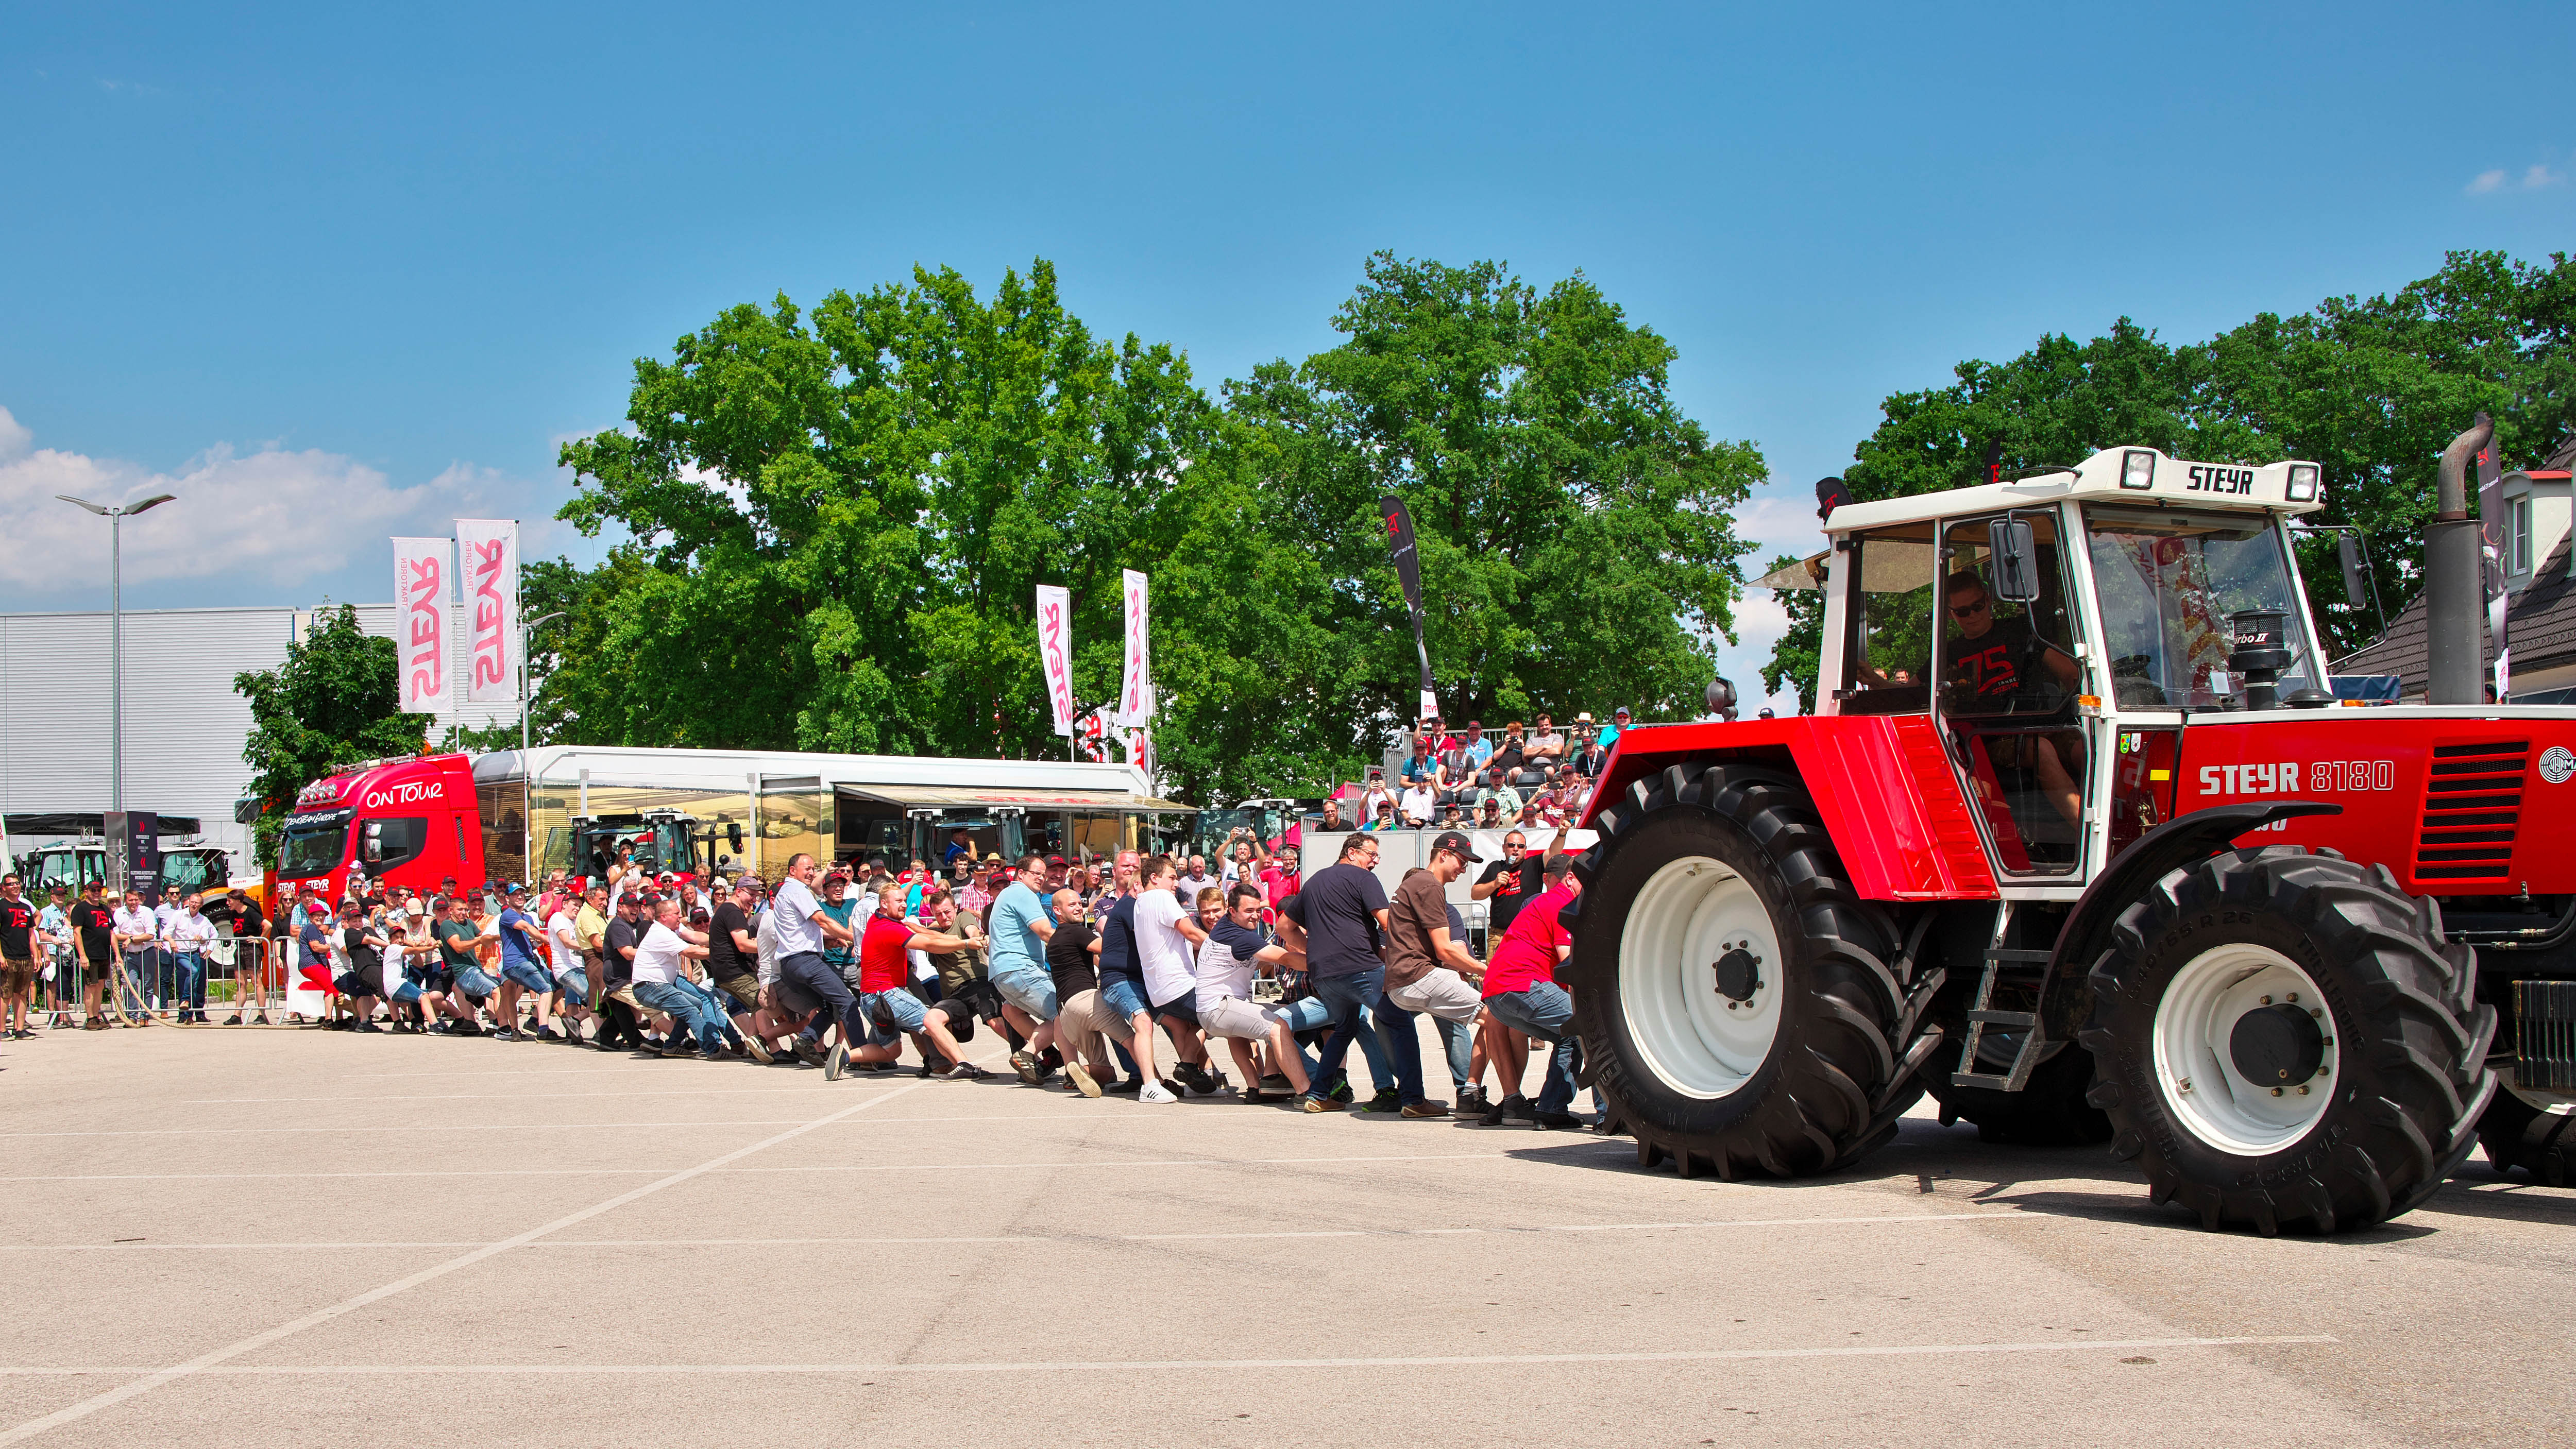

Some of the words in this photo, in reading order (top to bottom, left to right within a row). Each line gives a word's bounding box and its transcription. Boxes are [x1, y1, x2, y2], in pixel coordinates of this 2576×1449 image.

[2187, 465, 2253, 495] STEYR
[1958, 644, 2014, 693] 75
[2549, 757, 2564, 773] STEYR
[2199, 762, 2299, 795] STEYR
[2311, 760, 2394, 792] 8180
[367, 790, 394, 808] ON
[393, 781, 443, 803] TOUR
[314, 812, 338, 824] EUROPE
[1448, 839, 1457, 847] 75
[278, 882, 296, 893] STEYR
[306, 879, 329, 890] STEYR
[8, 908, 27, 927] 75
[91, 911, 108, 927] 75
[2200, 914, 2214, 928] R
[2222, 911, 2253, 924] 26
